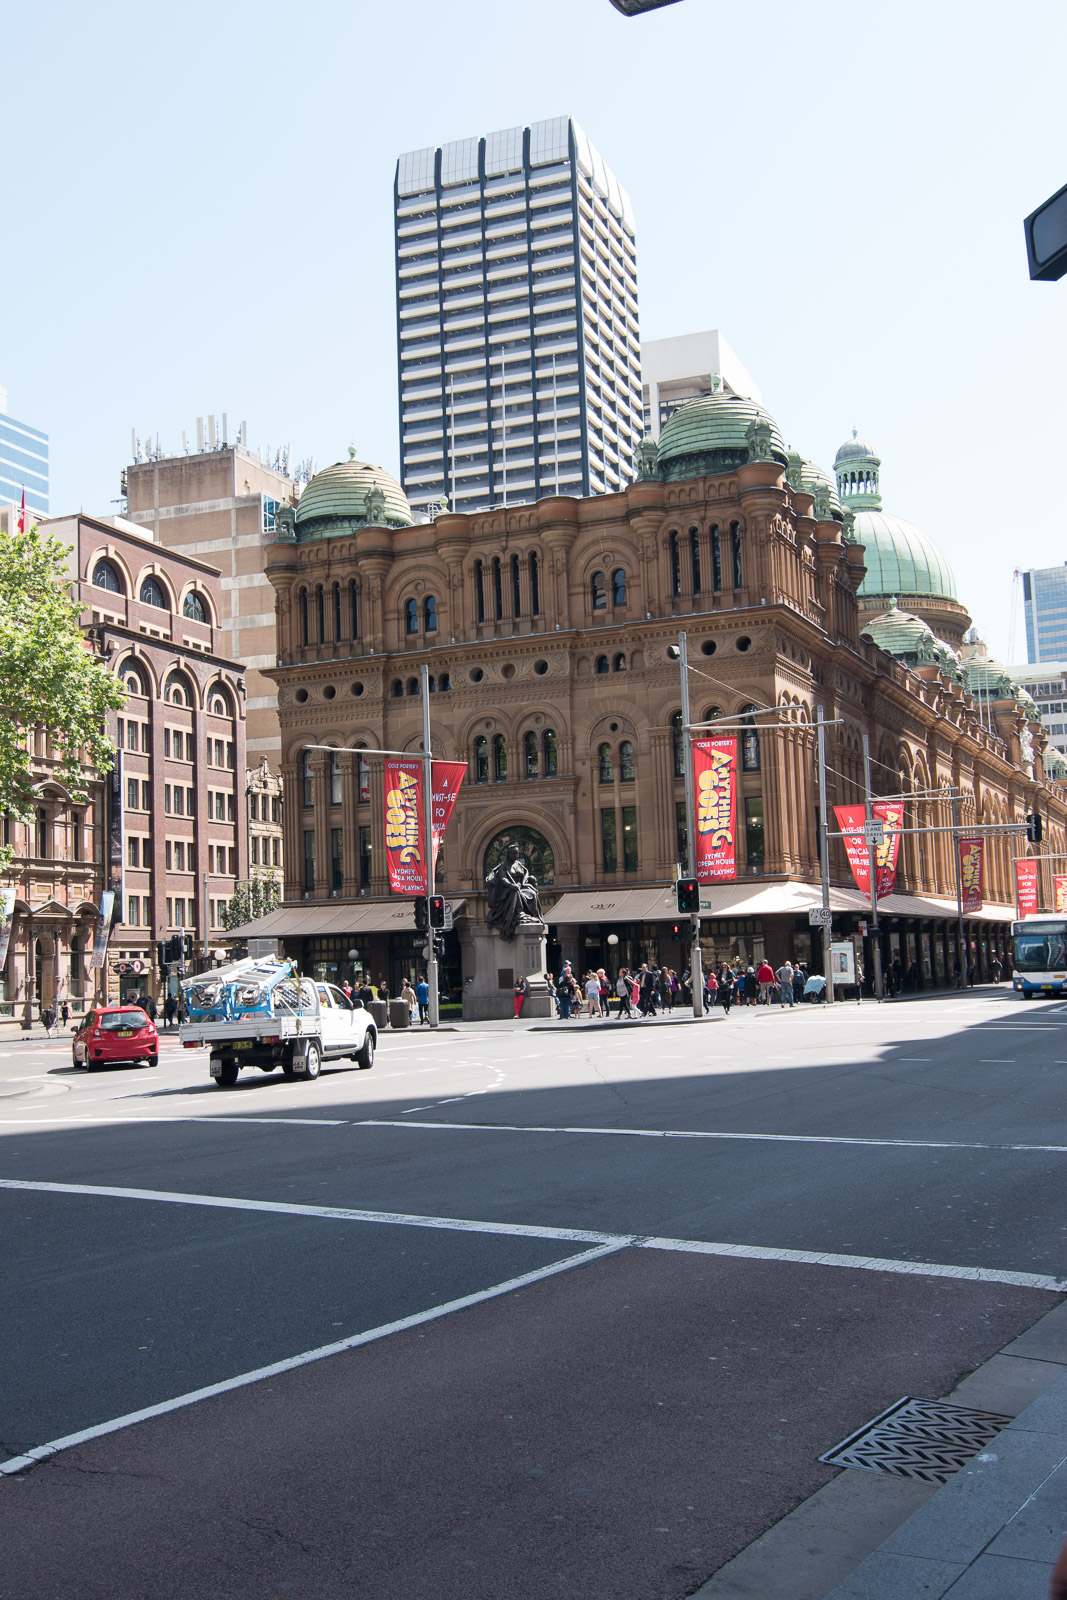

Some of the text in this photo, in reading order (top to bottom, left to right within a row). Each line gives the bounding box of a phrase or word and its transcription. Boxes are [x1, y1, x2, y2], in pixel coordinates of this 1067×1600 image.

[386, 790, 406, 851] GOES
[399, 770, 420, 865] ANYTHING
[698, 769, 719, 836] GOES
[711, 749, 734, 850] ANYTHING
[710, 868, 734, 876] PLAYING
